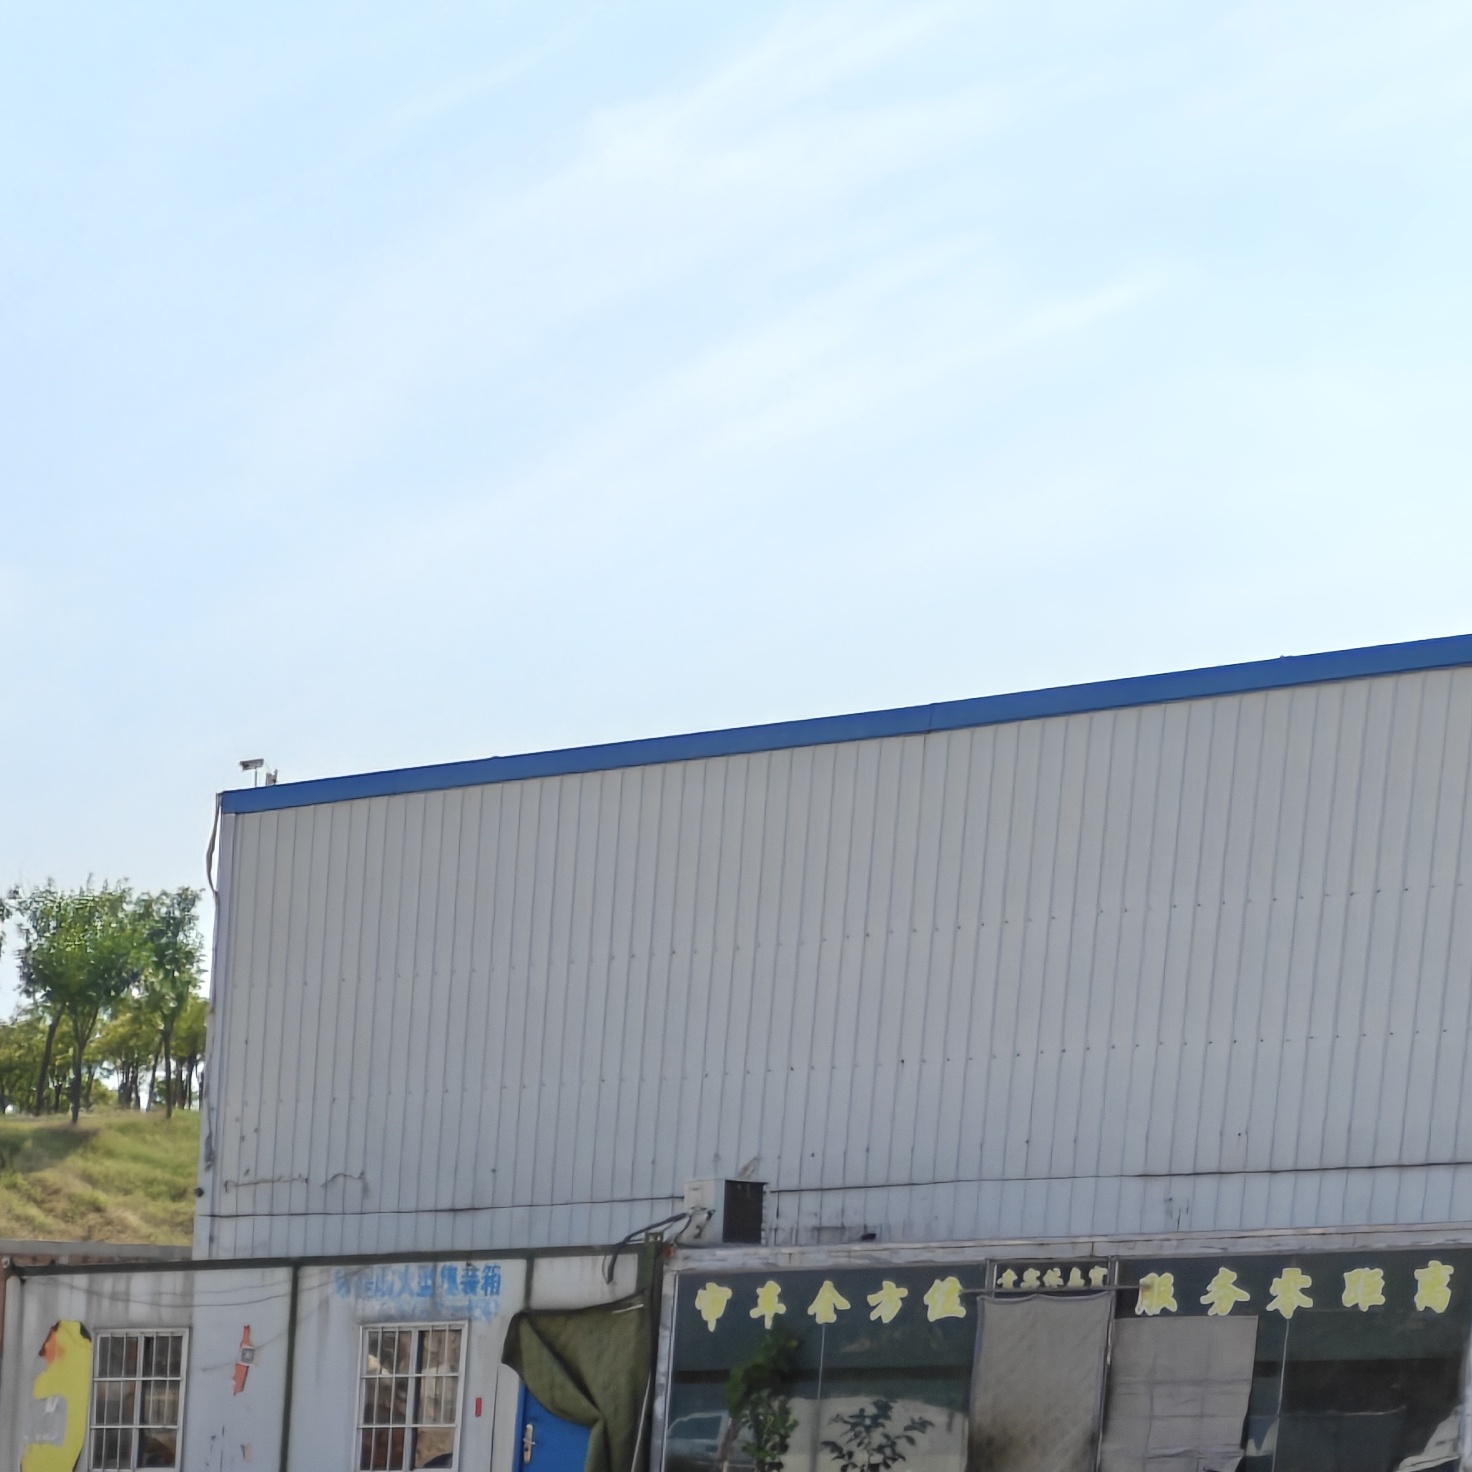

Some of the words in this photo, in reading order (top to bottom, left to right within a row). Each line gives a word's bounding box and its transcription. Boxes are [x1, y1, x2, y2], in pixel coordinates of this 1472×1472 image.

[1135, 1259, 1454, 1319] 服务零距离
